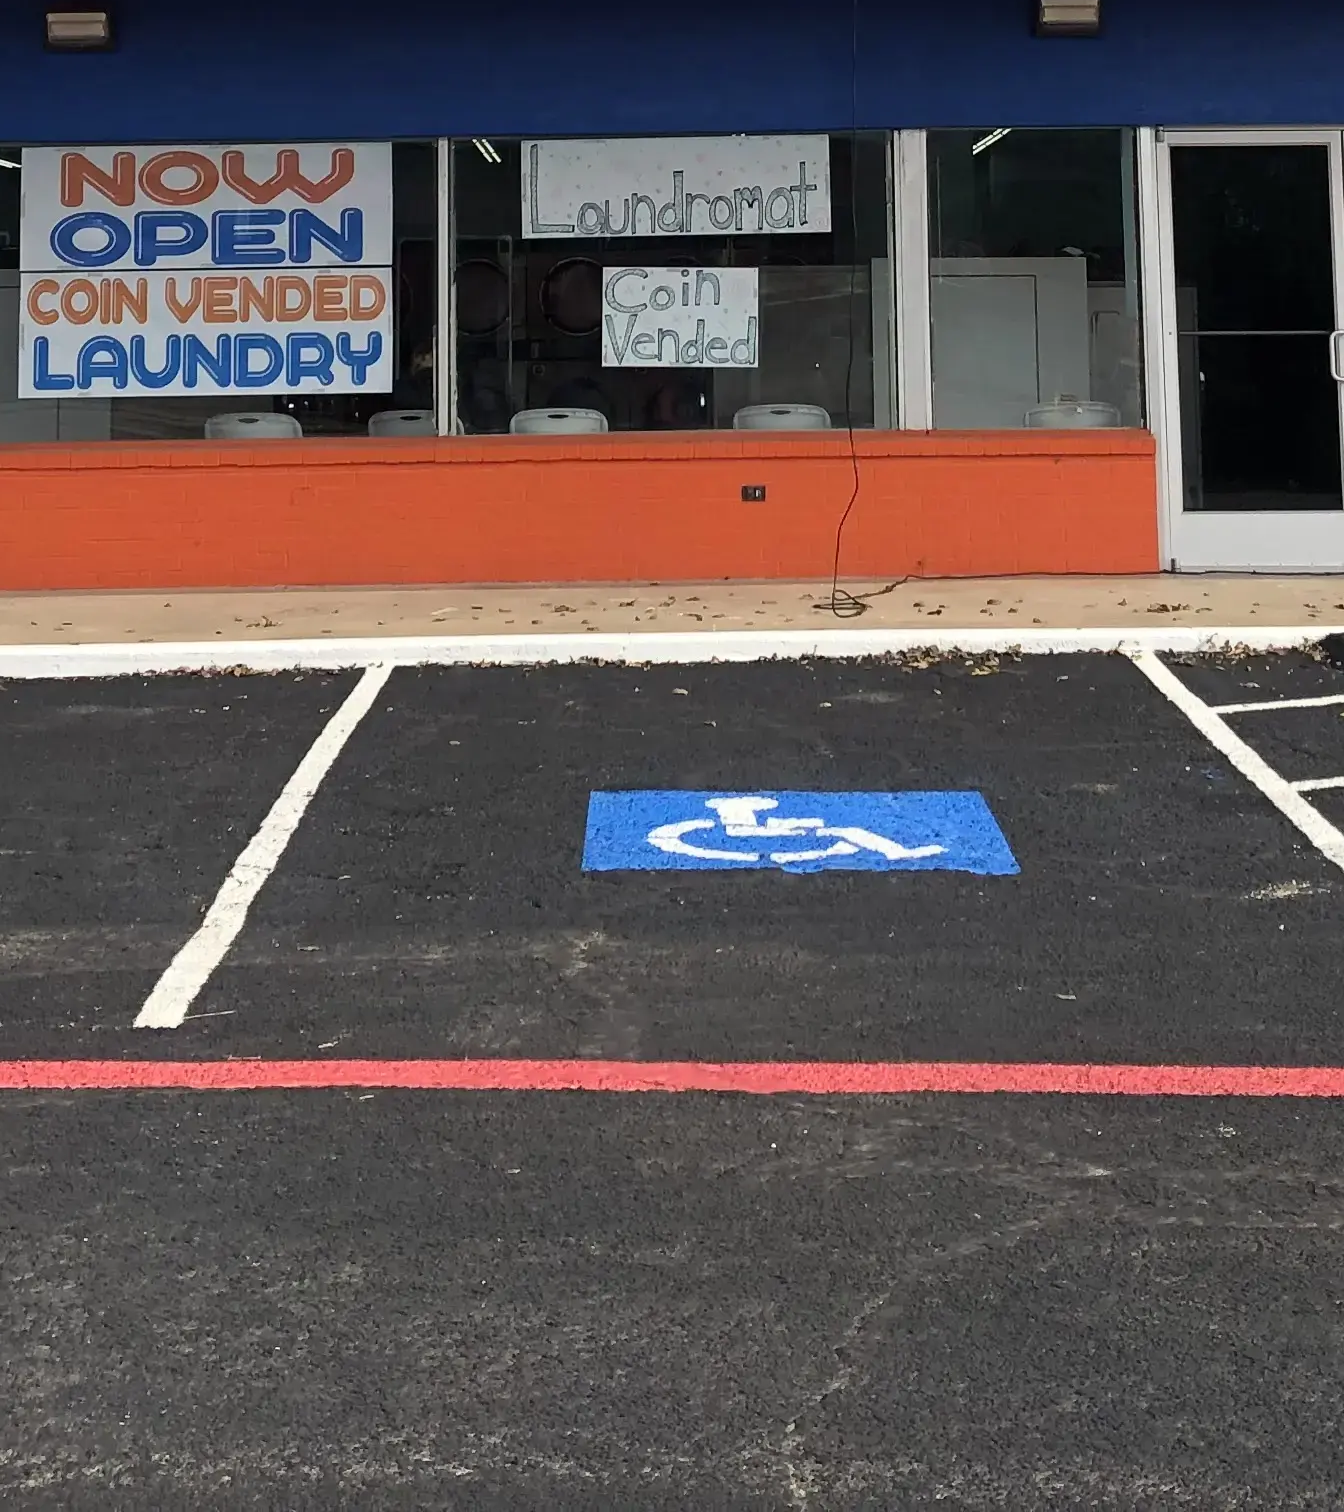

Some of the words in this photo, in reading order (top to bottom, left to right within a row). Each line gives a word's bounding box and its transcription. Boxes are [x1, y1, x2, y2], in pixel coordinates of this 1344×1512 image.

[60, 147, 355, 207] NOW
[529, 143, 818, 235] Laundromat
[49, 207, 364, 267] OPEN
[26, 277, 148, 325] COIN
[164, 274, 387, 324] VENDED
[604, 268, 722, 314] Coin
[32, 330, 383, 390] LAUNDRY
[603, 313, 758, 366] Vended
